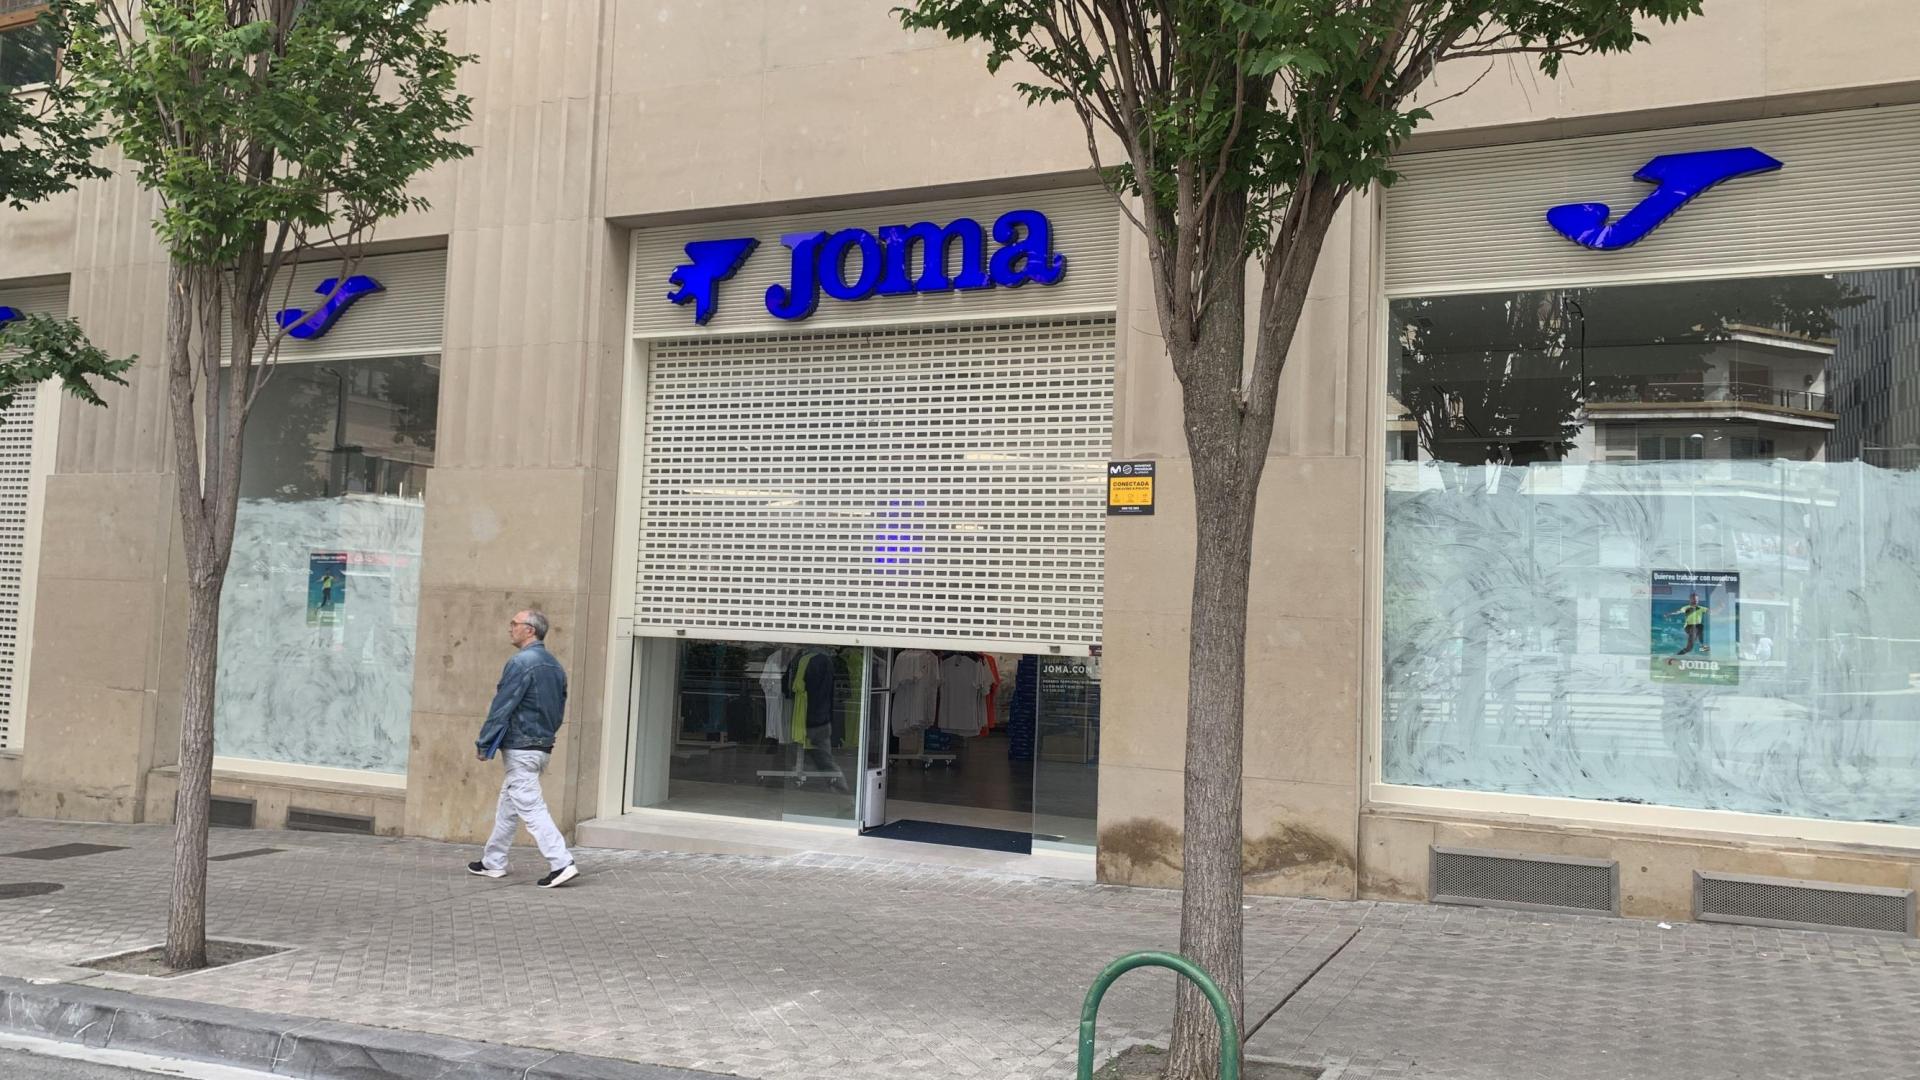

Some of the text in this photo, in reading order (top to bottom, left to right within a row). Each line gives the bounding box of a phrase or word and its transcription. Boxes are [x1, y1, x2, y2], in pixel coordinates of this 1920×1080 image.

[1653, 573, 1676, 581] Quieres
[1711, 574, 1738, 582] nosotros
[1043, 665, 1093, 674] JOMA.COM
